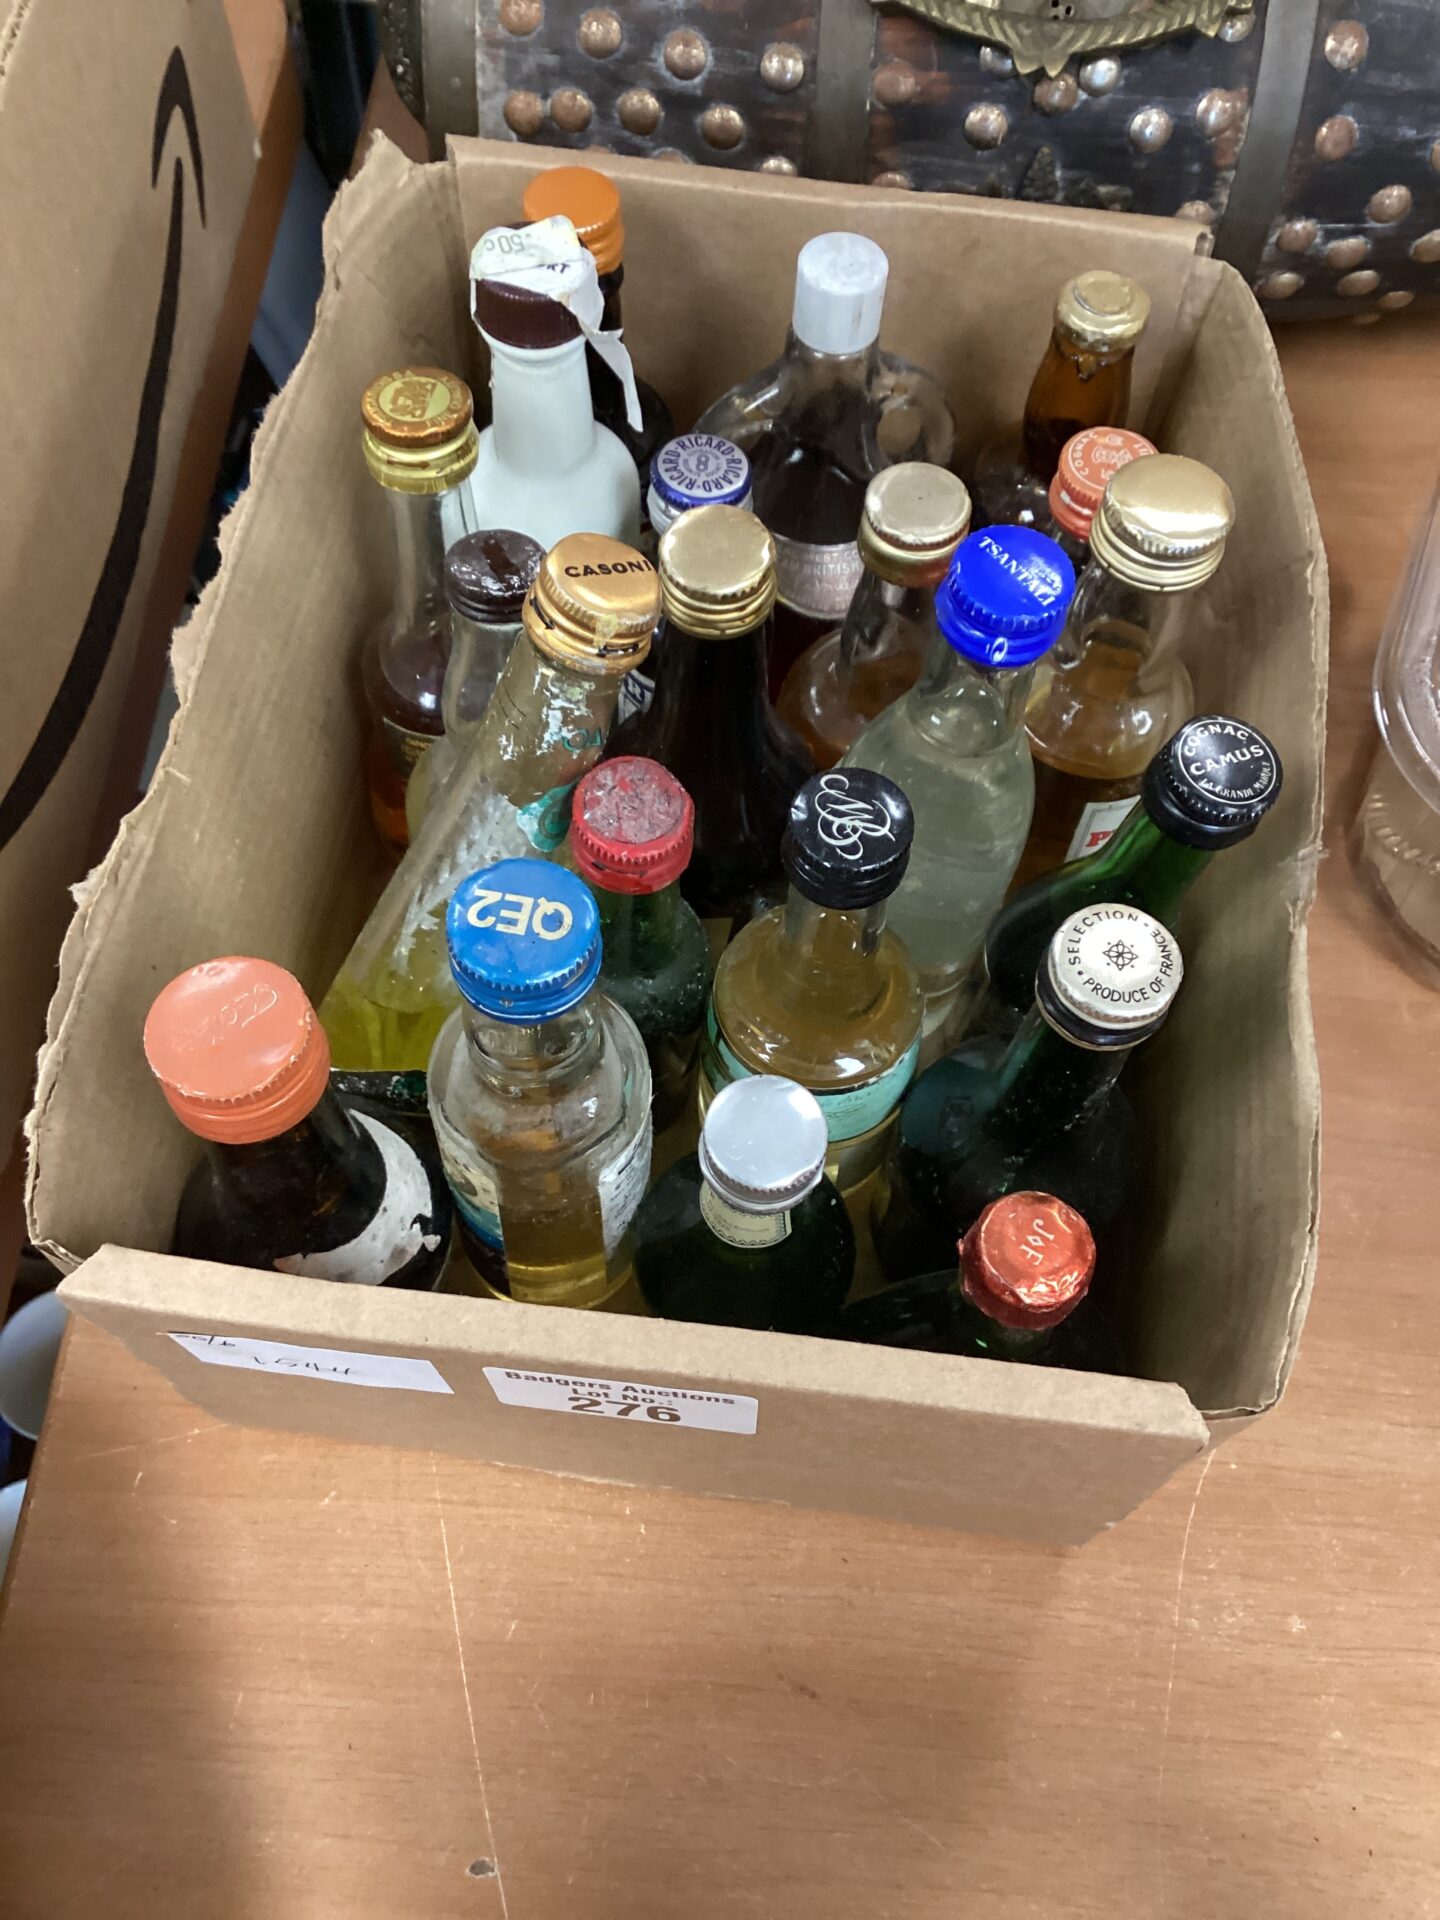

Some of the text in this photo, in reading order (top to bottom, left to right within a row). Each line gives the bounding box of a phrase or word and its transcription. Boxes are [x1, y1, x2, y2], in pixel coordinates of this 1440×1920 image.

[676, 435, 736, 456] RICARD
[662, 449, 698, 491] RICARD
[702, 457, 743, 492] RICARD
[564, 558, 654, 579] CASONI
[978, 536, 1056, 606] TSANTALI
[1184, 724, 1249, 757] COGNAC
[1190, 744, 1265, 776] CAMUS
[467, 887, 573, 941] QE2
[1067, 910, 1139, 966] SELECTION
[1082, 928, 1175, 1004] PRODUCE OF FRANCE
[503, 1371, 736, 1406] Badgers Auctions
[572, 1388, 611, 1400] Lot
[567, 1396, 682, 1424] 276
